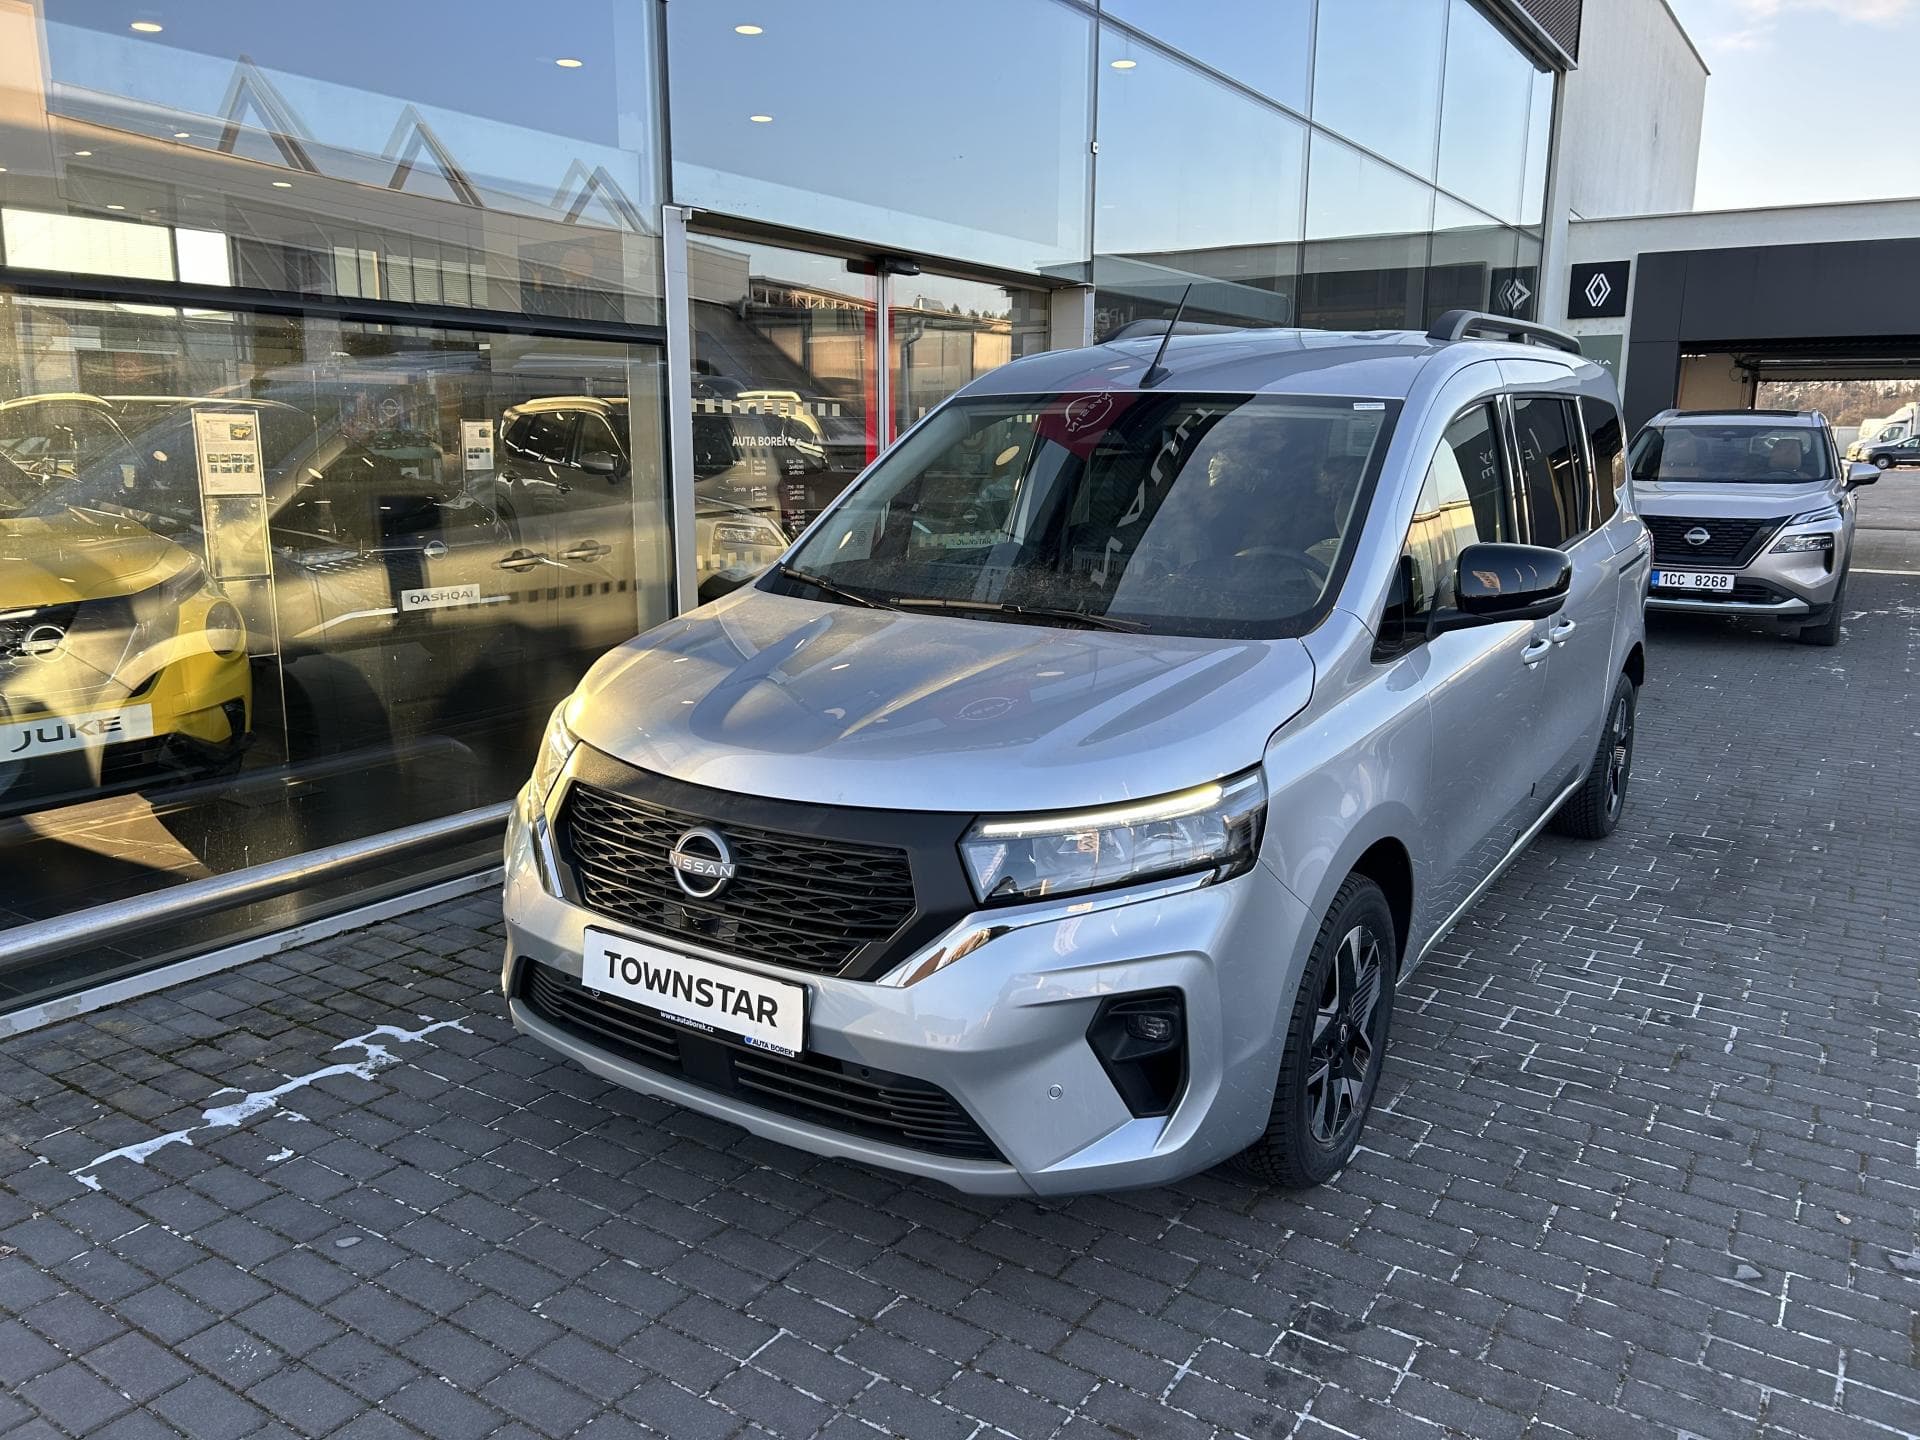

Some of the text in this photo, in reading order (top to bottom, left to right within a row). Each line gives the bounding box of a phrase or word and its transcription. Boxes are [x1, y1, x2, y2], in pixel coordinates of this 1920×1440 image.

[732, 436, 756, 446] AUTA
[758, 436, 788, 446] BOREK
[1662, 573, 1685, 585] 1CC
[1694, 575, 1728, 587] 8268
[410, 590, 473, 604] QASHQAI
[10, 716, 122, 753] JUKE
[669, 850, 732, 877] NISSAN
[604, 950, 778, 1027] TOWNSTAR
[660, 1011, 714, 1033] www.autaborek.cz
[752, 1039, 794, 1057] AUTA BOREK
